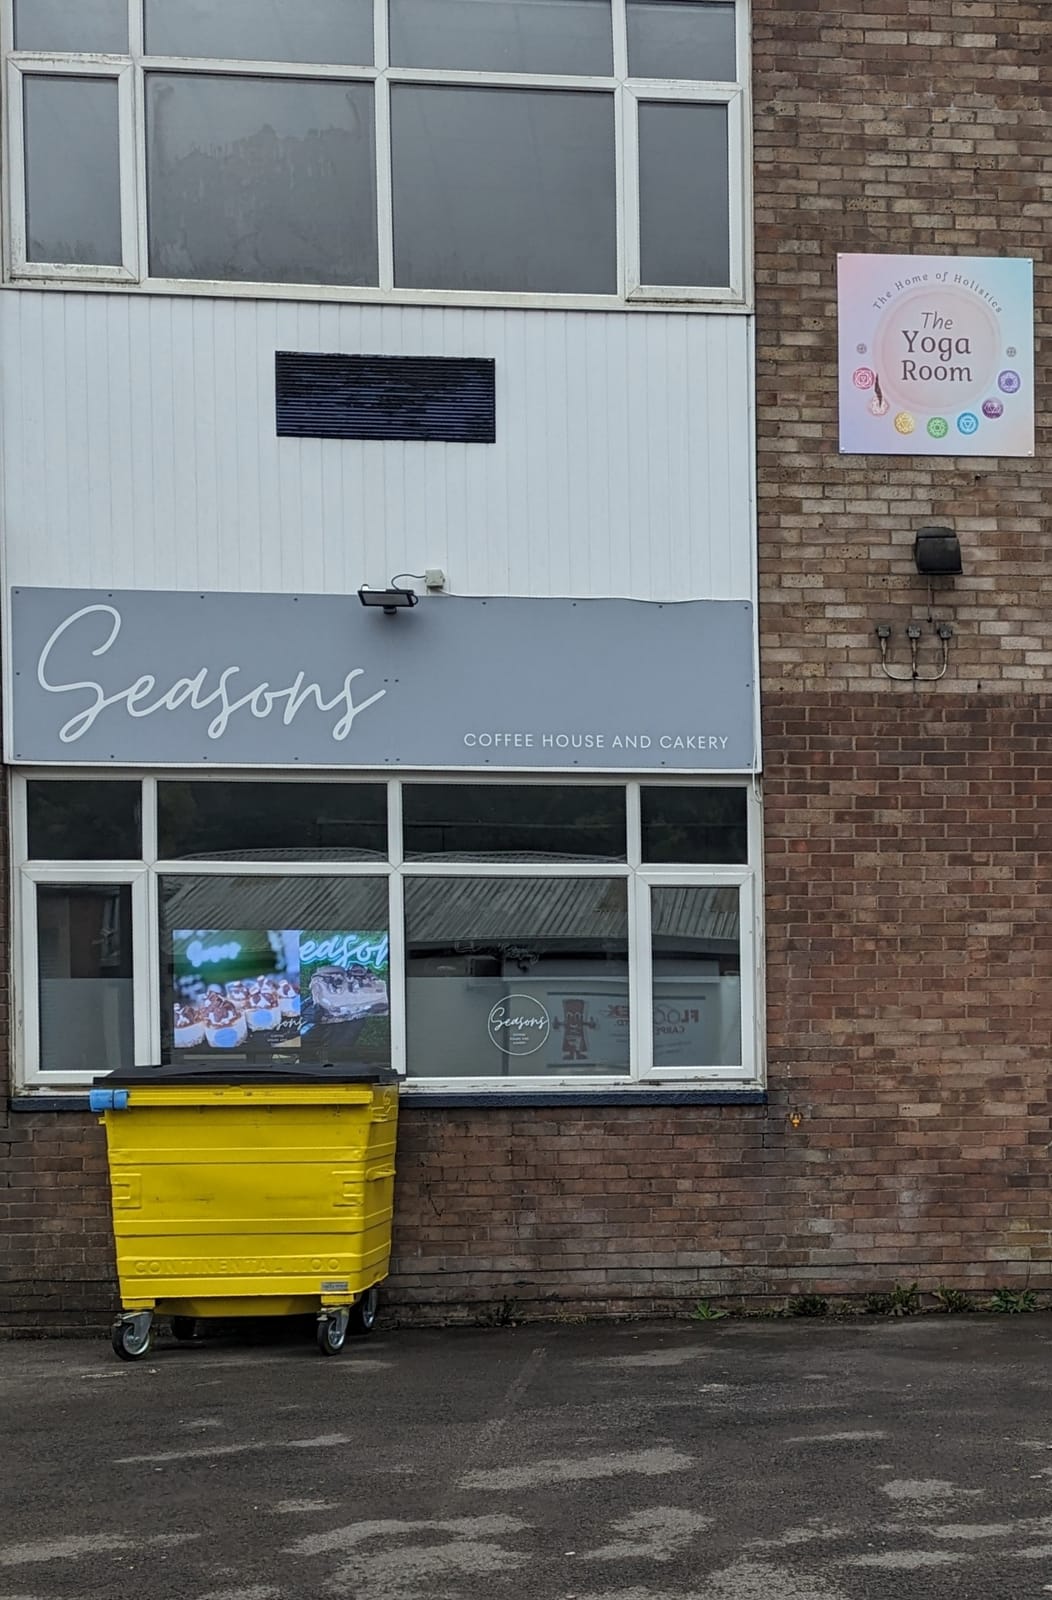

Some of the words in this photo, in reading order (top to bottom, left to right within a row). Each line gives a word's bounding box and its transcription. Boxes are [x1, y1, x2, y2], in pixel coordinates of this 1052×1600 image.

[873, 291, 893, 310] The
[895, 274, 928, 291] Home
[936, 272, 949, 283] of
[954, 274, 1002, 313] Holistics
[921, 311, 954, 330] The
[902, 330, 971, 361] Yoga
[901, 360, 972, 382] Room
[37, 604, 387, 742] Seasons
[463, 733, 534, 747] COFFEE
[543, 734, 605, 748] HOUSE
[612, 735, 651, 749] AND
[659, 736, 729, 749] CAKERY
[490, 1006, 549, 1031] Seasons
